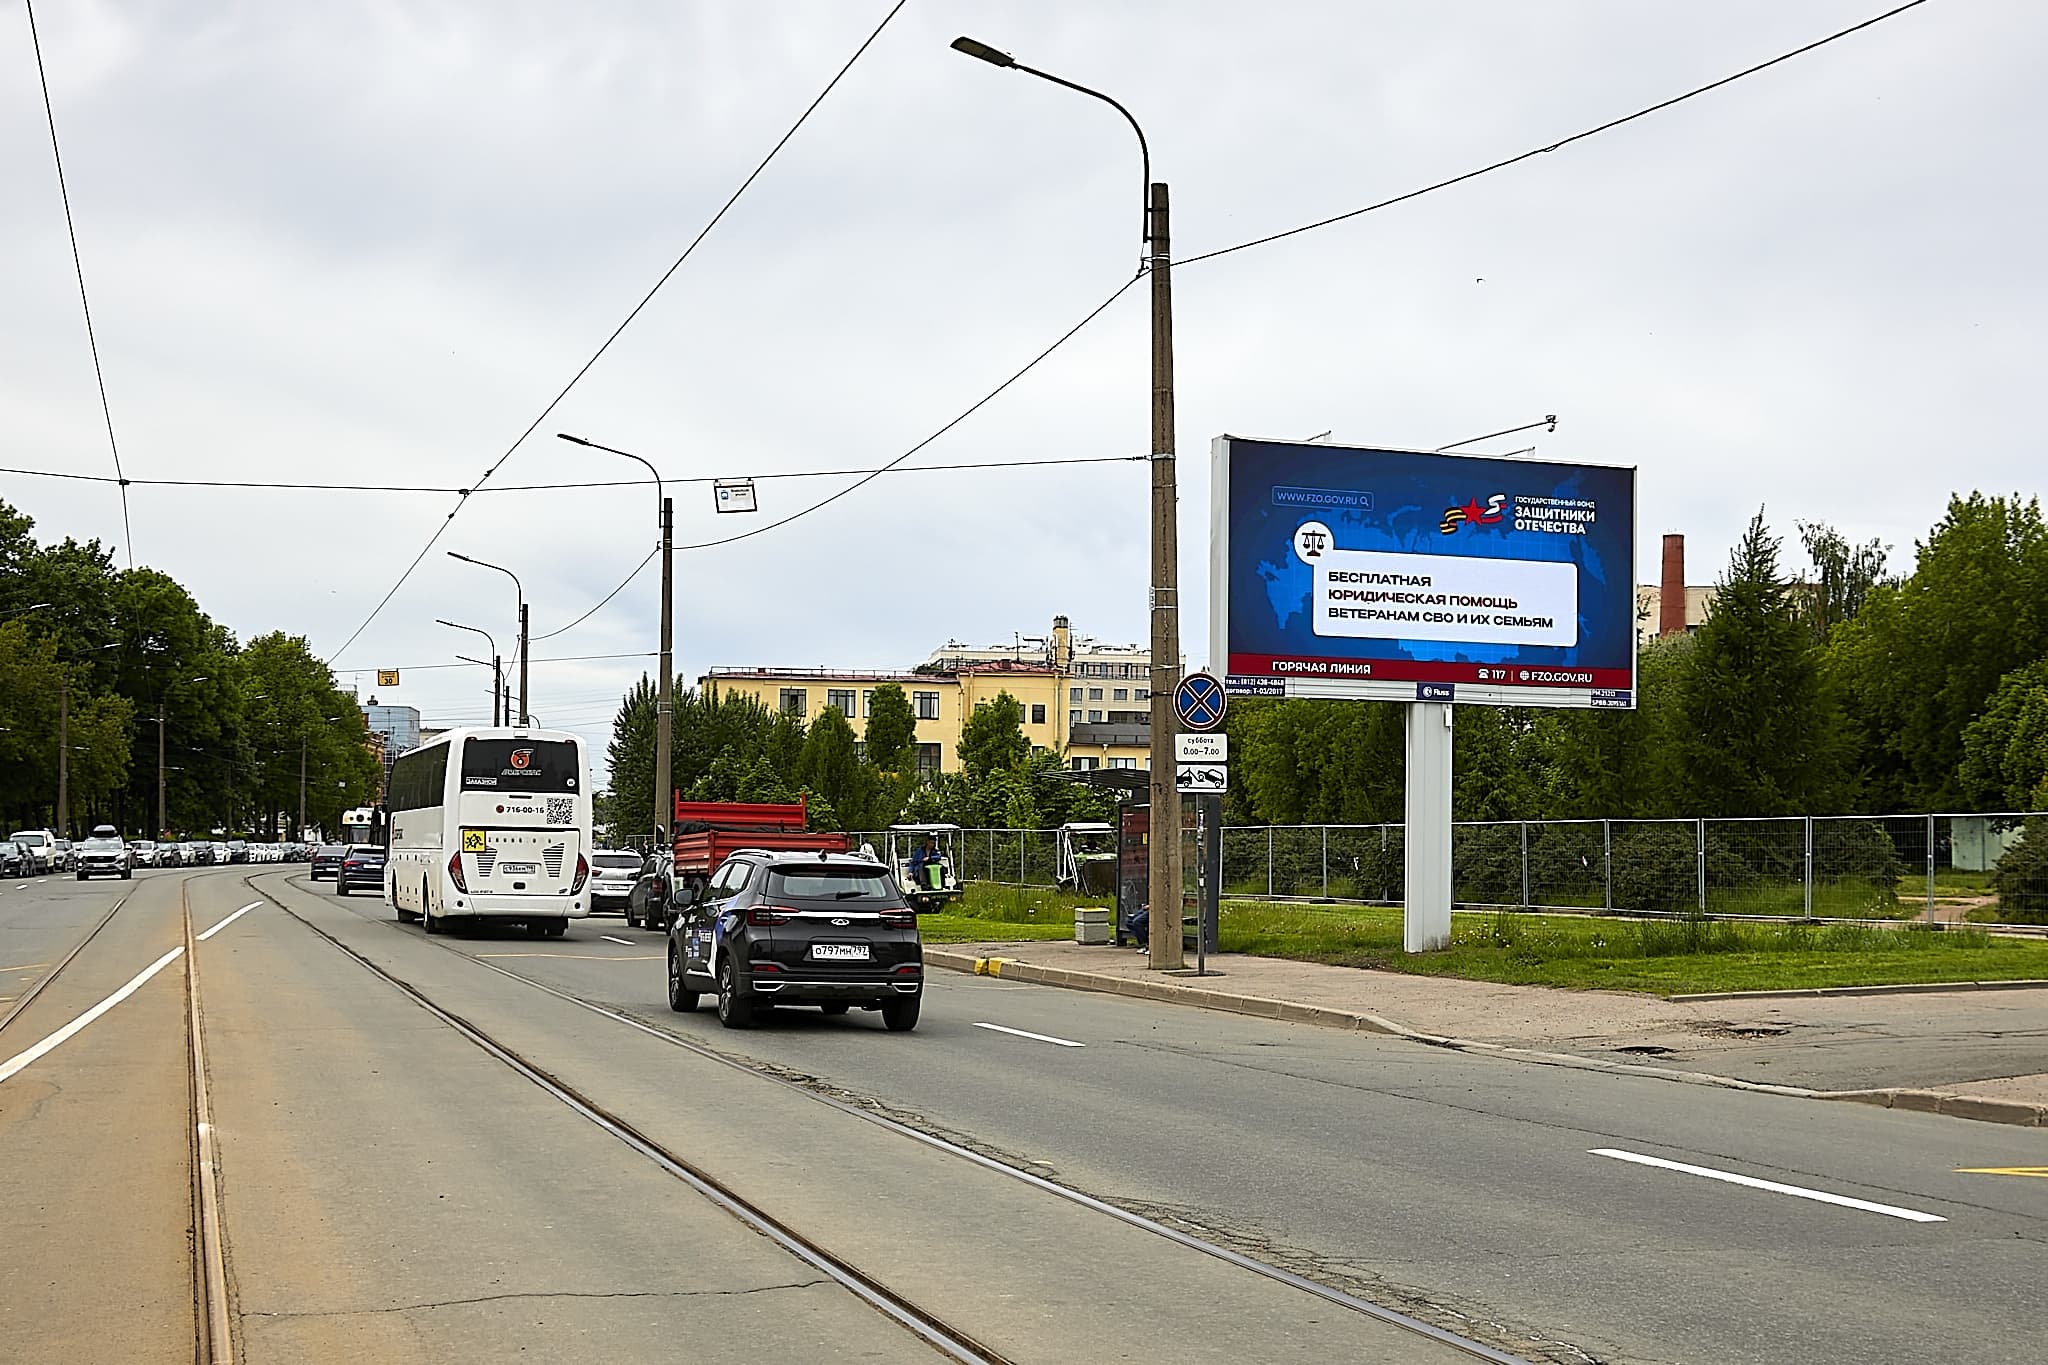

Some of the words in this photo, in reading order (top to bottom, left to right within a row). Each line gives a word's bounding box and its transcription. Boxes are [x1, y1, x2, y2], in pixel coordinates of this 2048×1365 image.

[1276, 491, 1358, 505] WWW.FZO.GOV.RU
[1576, 500, 1595, 509] ФОНД
[1515, 506, 1595, 522] ЗАЩИТНИКИ
[1515, 519, 1586, 534] ОТЕЧЕСТВА
[1328, 571, 1431, 587] БЕСПЛАТНАЯ
[1328, 589, 1446, 605] ЮРИДИЧЕСКАЯ
[1449, 595, 1518, 609] ПОМОЩЬ
[1328, 607, 1420, 621] ВЕТЕРАНАМ
[1422, 612, 1454, 623] СВО
[1457, 613, 1468, 624] И
[1470, 614, 1490, 625] ИХ
[1493, 616, 1553, 628] СЕМЬЯМ
[1272, 661, 1327, 673] ГОРЯЧАЯ
[1330, 664, 1371, 674] ЛИНИЯ
[1492, 669, 1506, 680] 117
[1531, 671, 1593, 683] FZO.GOV.RU
[1187, 737, 1214, 745] суббота
